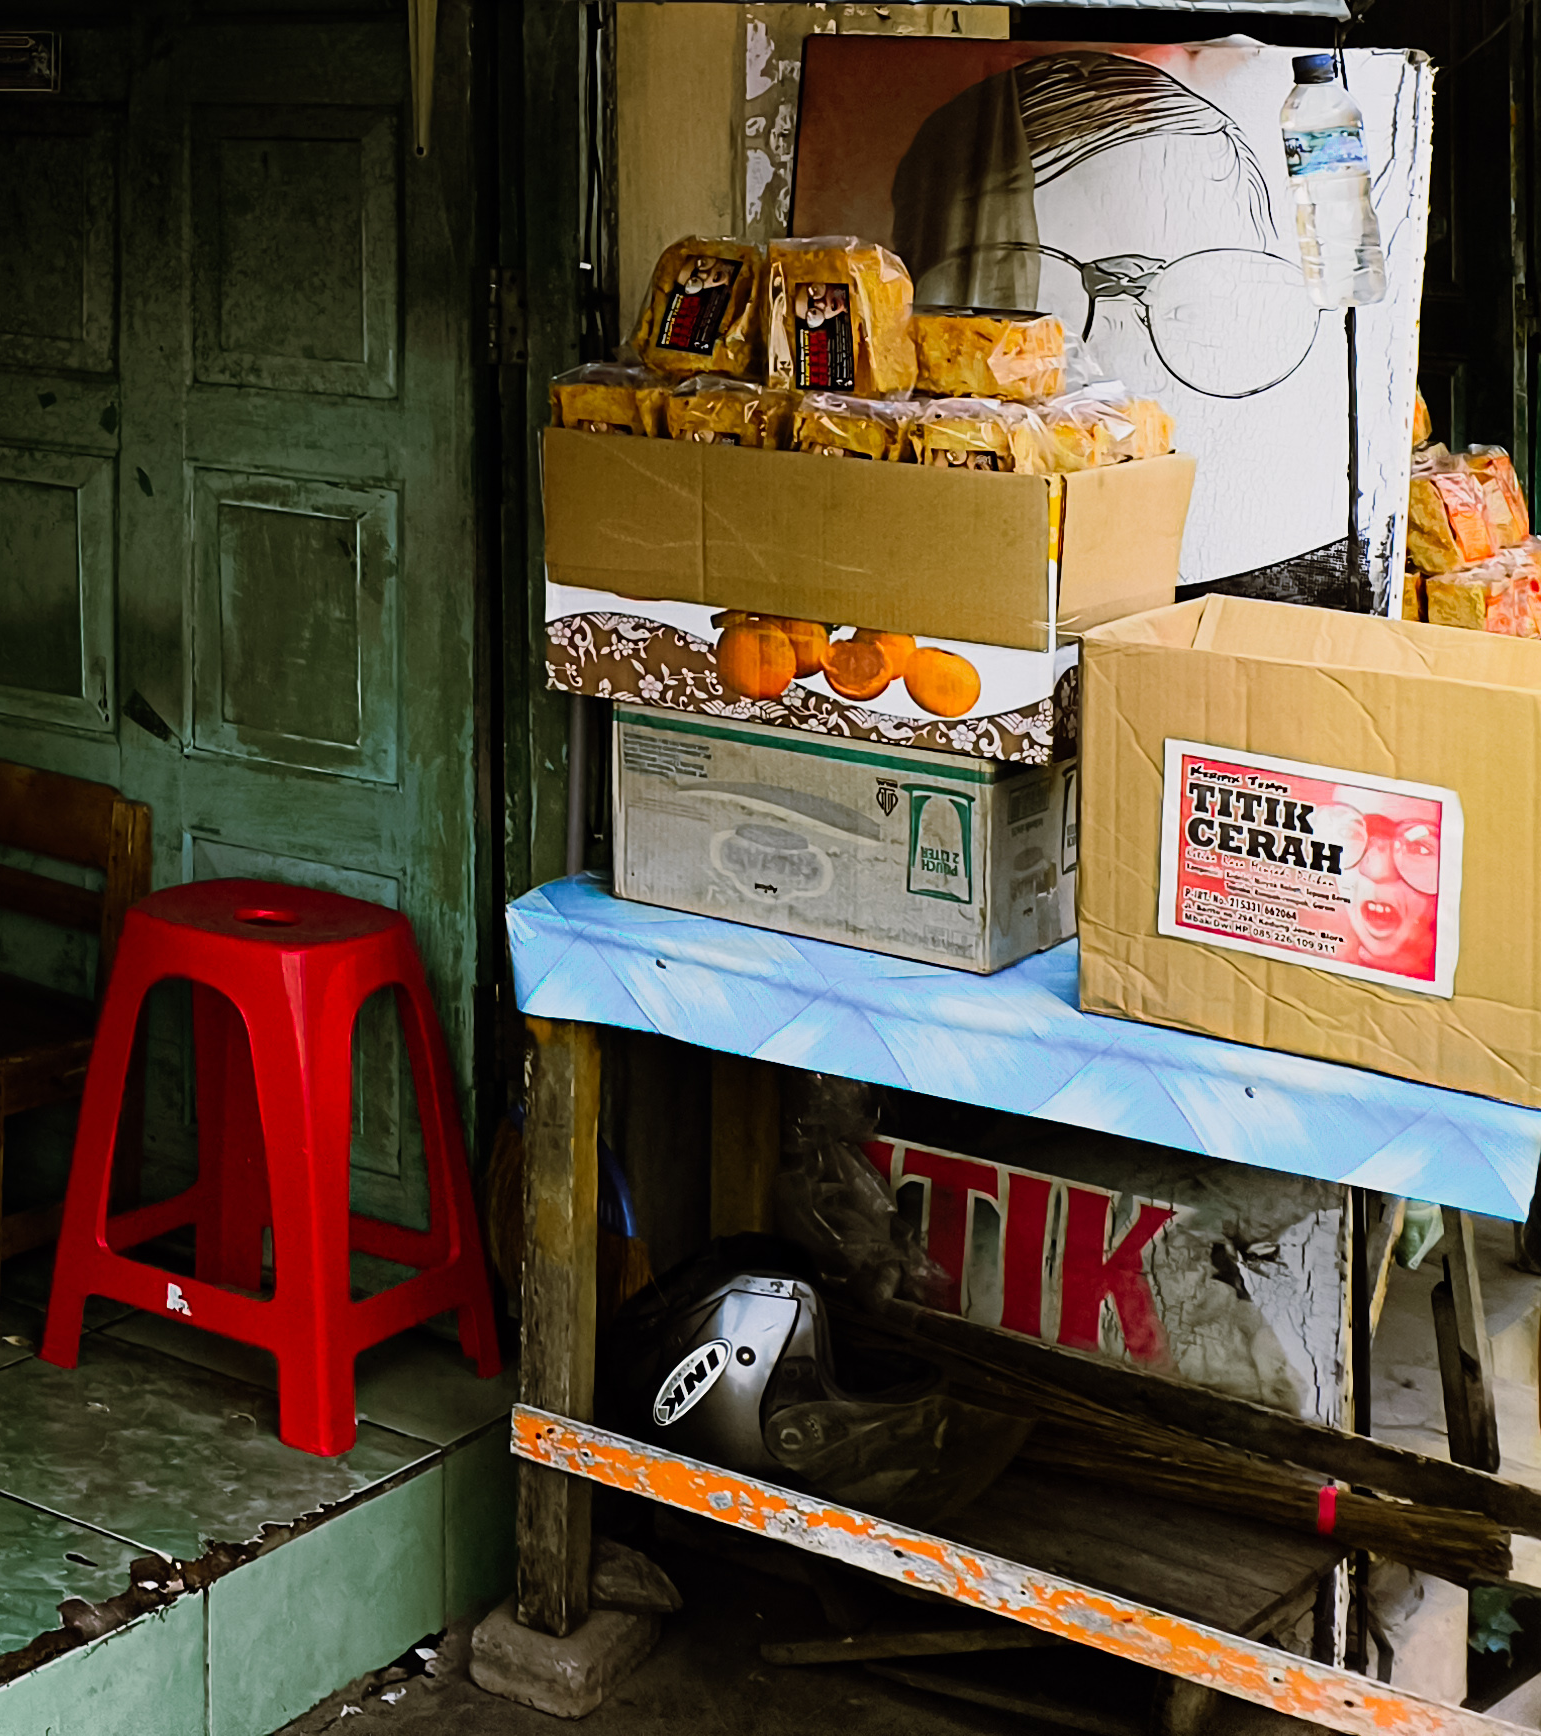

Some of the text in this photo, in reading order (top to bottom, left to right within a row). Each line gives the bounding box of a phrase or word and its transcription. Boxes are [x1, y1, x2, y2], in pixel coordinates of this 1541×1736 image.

[1188, 782, 1314, 835] TITIK
[921, 859, 958, 877] POUCH
[1187, 817, 1344, 876] CERAH
[1253, 927, 1271, 938] 085
[1274, 932, 1293, 944] 226
[1296, 937, 1315, 949] 109
[1317, 942, 1336, 953] 911
[859, 1139, 1179, 1377] TIK
[659, 1348, 720, 1421] INK
